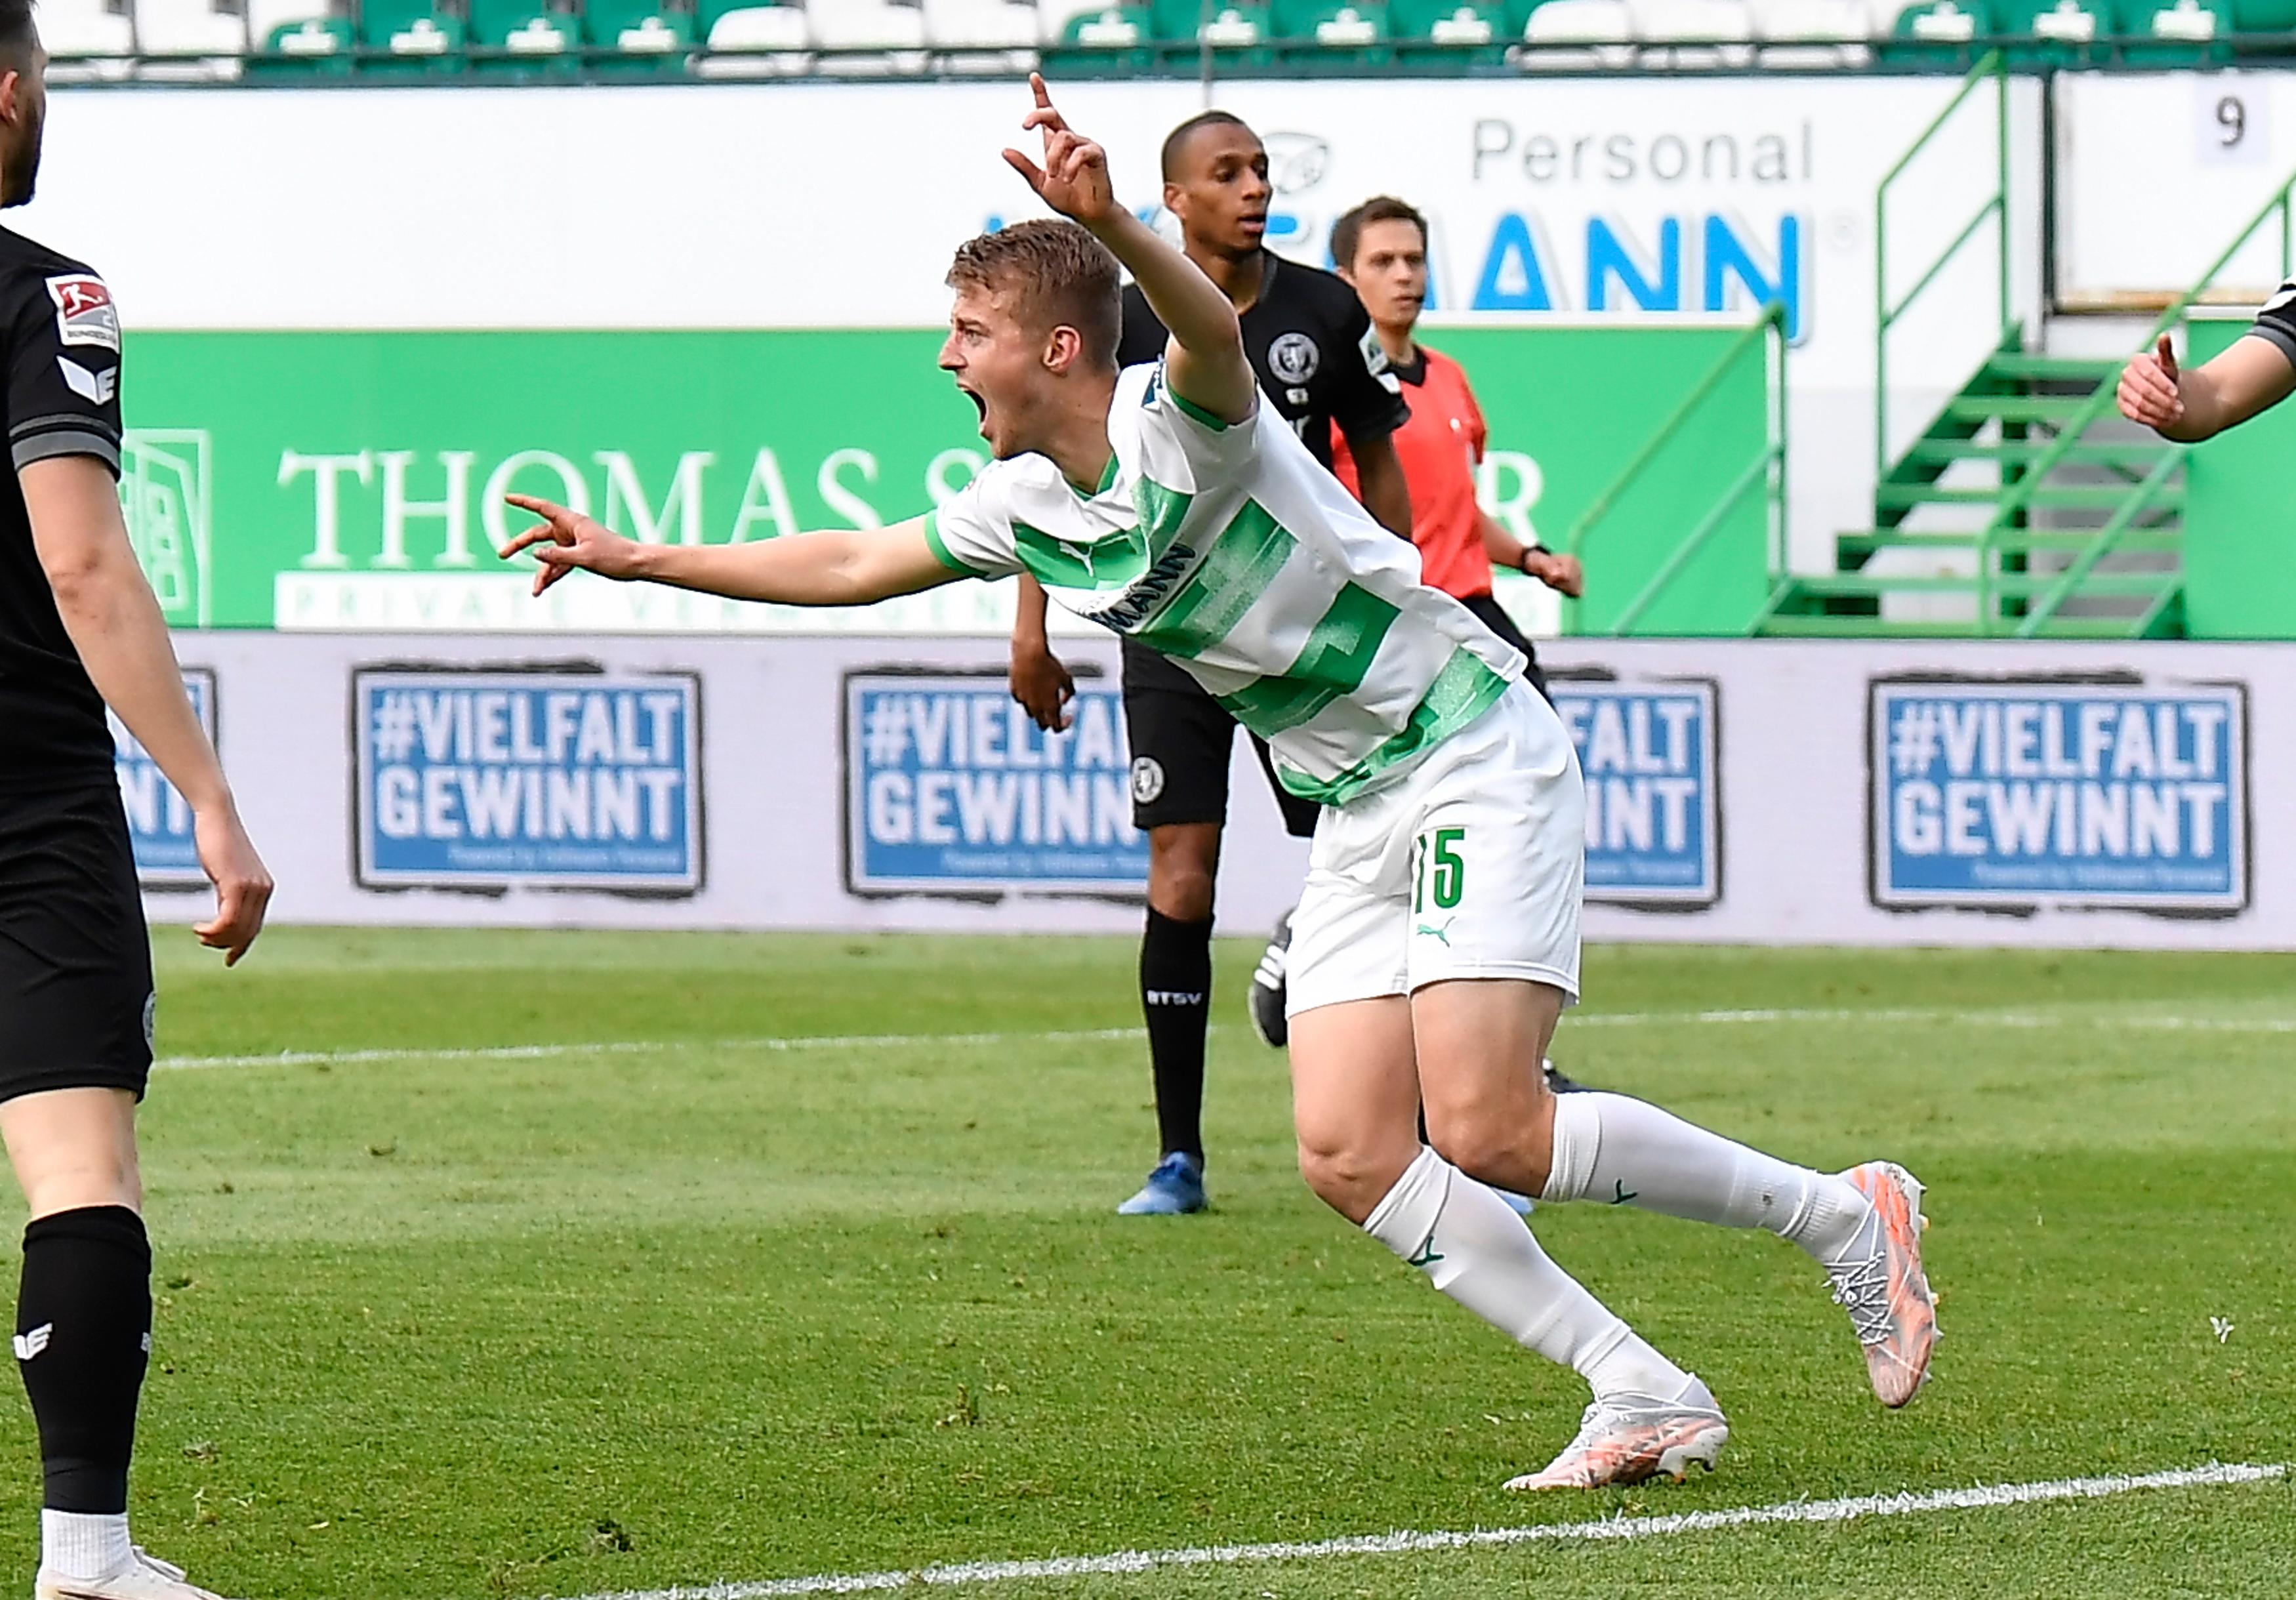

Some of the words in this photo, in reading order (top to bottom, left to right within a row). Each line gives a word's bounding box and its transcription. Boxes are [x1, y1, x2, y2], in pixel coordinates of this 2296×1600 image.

[1471, 118, 1812, 181] Personal
[2217, 96, 2245, 146] 9
[277, 447, 884, 569] THOMAS
[374, 691, 680, 764] #VIELFALT
[1892, 701, 2226, 779] #VIELFALT
[378, 764, 680, 840] GEWINNT
[1895, 781, 2226, 858] GEWINNT
